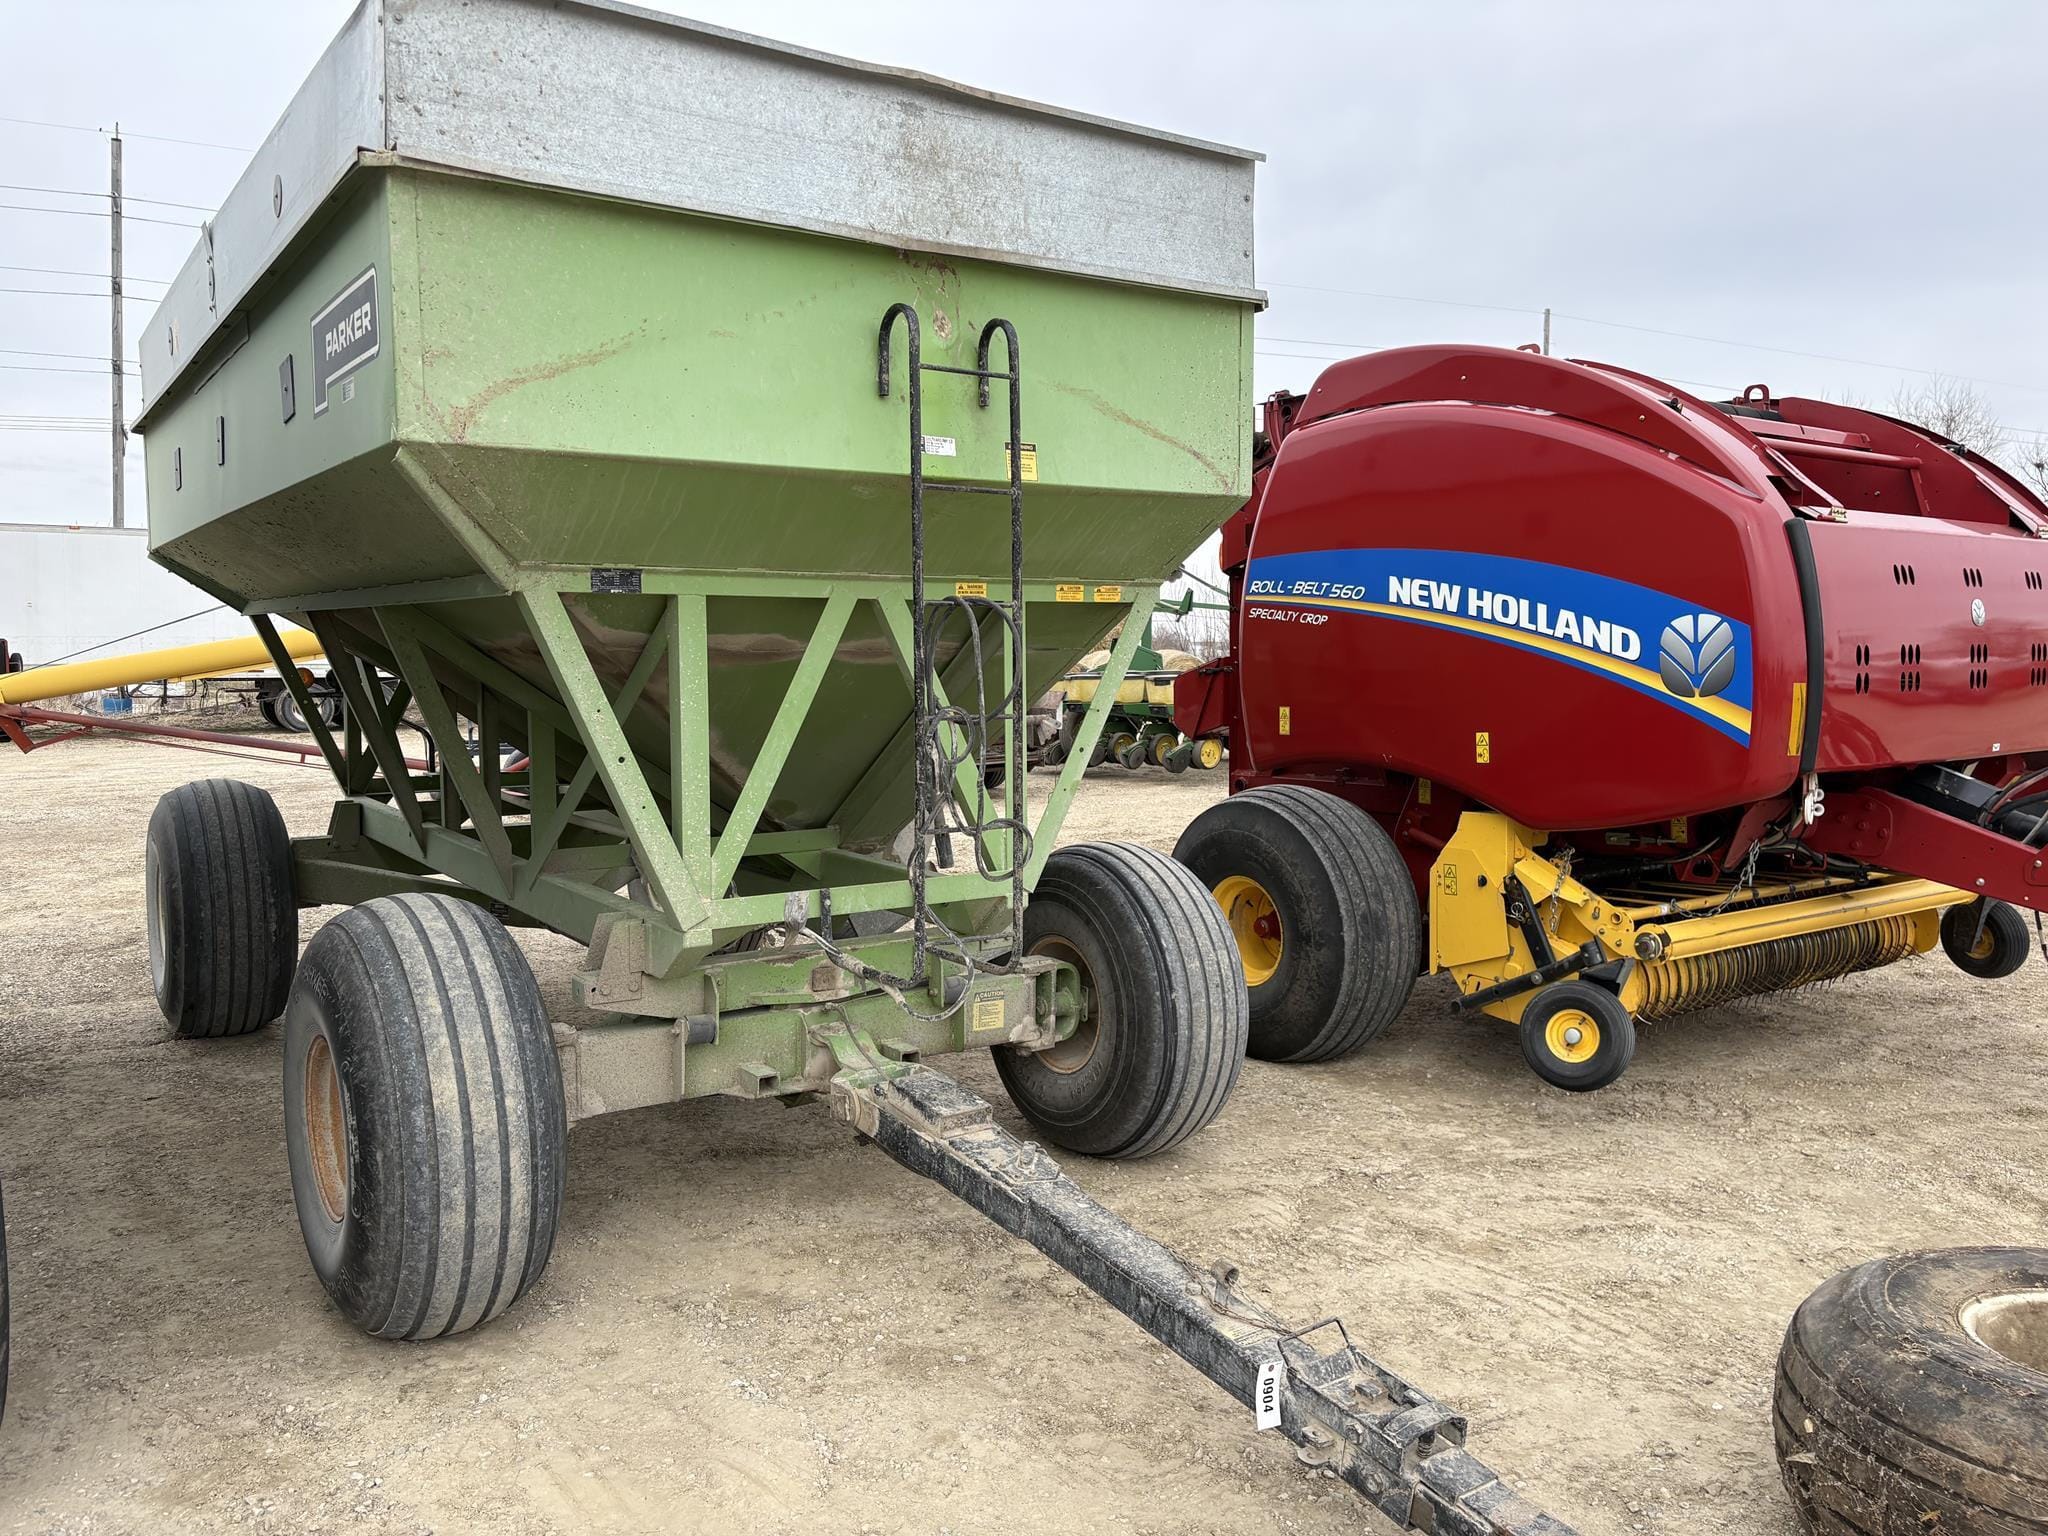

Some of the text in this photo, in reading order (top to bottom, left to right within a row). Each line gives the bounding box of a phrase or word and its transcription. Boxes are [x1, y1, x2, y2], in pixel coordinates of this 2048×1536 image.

[325, 302, 372, 361] PARKER
[1329, 584, 1366, 600] 560
[1249, 607, 1329, 626] SPECIALTY CROP
[1388, 575, 1641, 662] NEW HOLLAND
[1263, 1378, 1274, 1413] 0904
